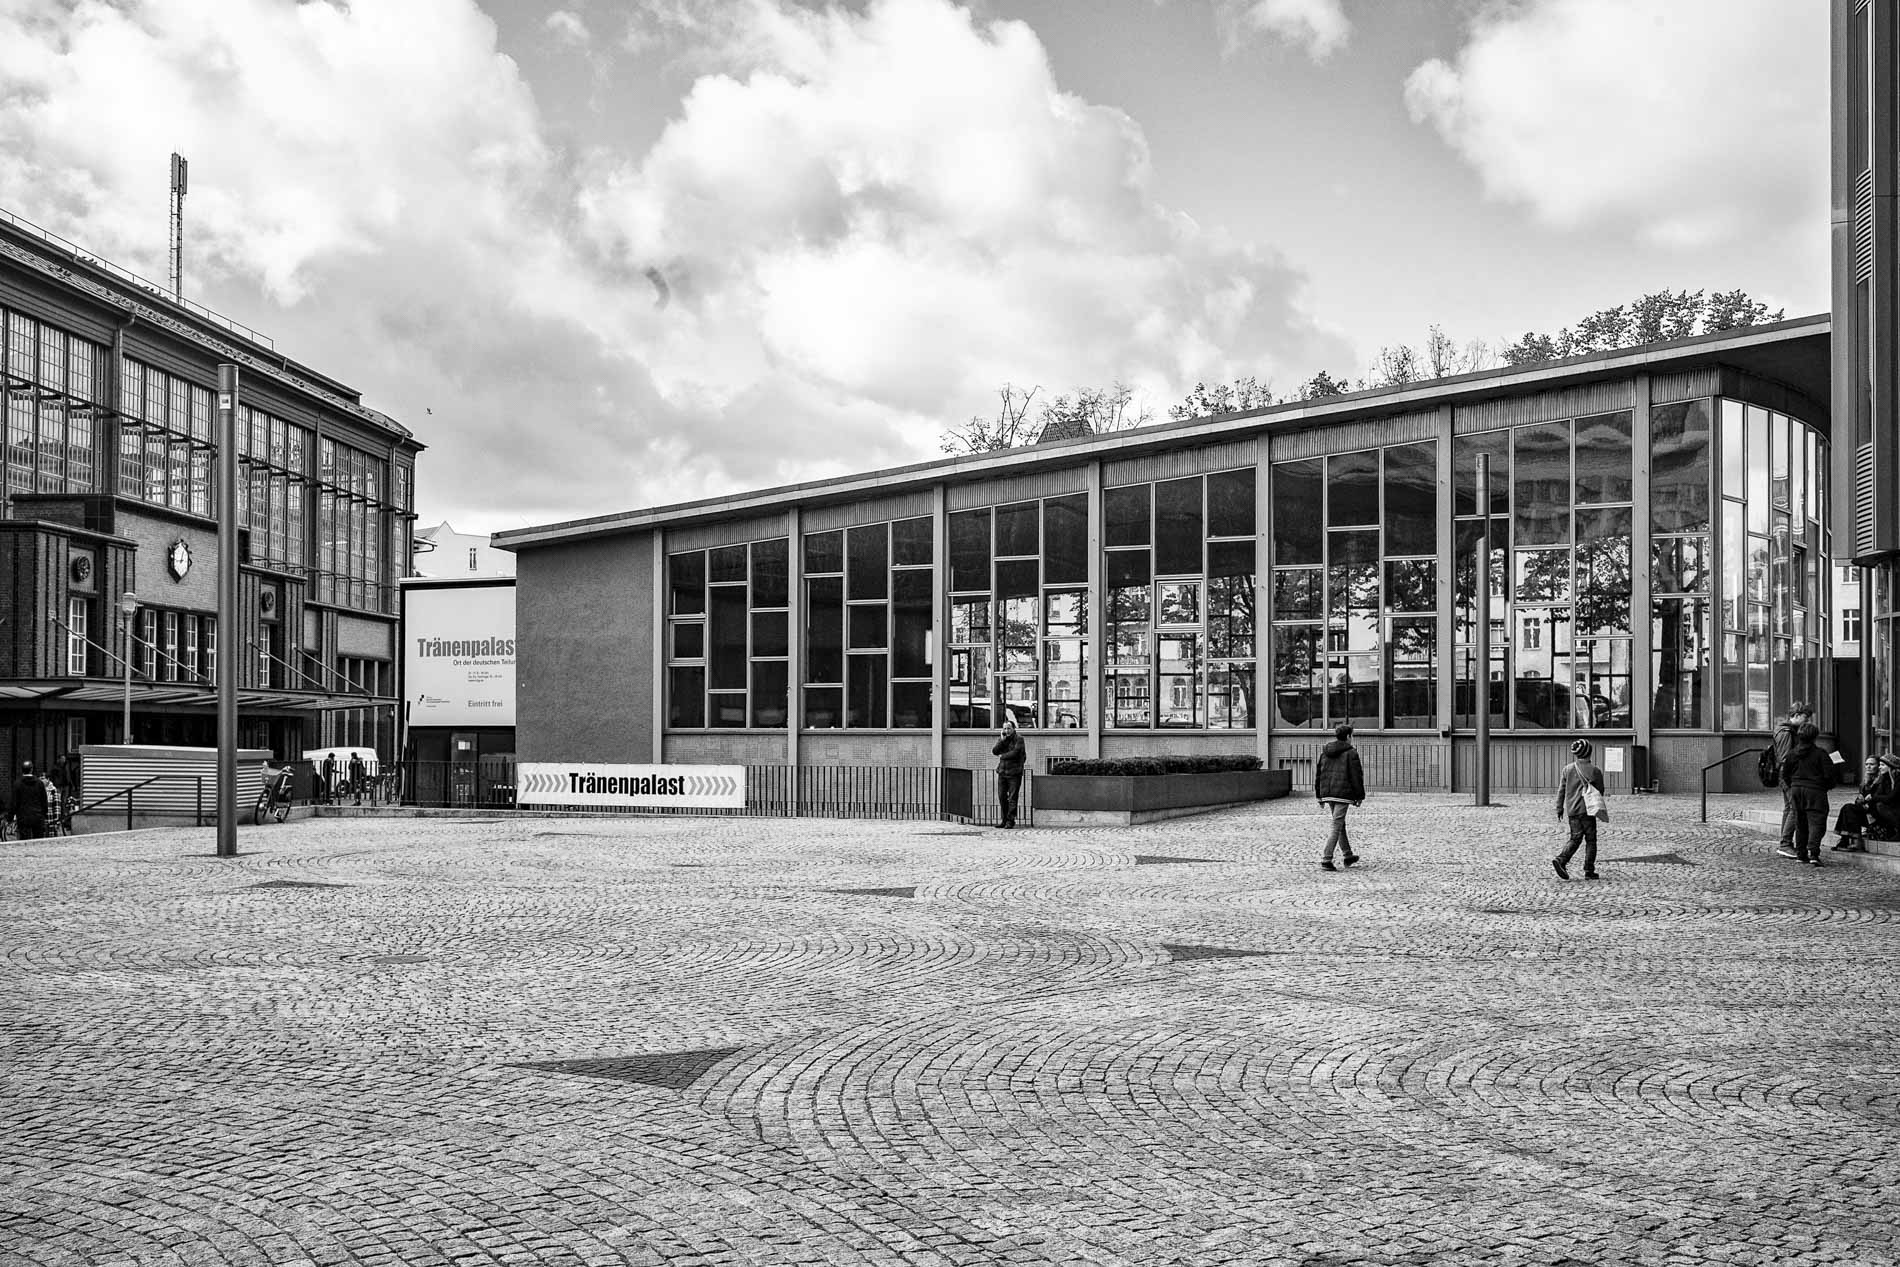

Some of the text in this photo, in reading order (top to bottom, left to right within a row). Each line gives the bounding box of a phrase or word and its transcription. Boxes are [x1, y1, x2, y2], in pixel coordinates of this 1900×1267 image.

[417, 636, 516, 658] Tränenpalas
[468, 700, 490, 708] Eintritt
[569, 772, 684, 796] Tränenpalast
